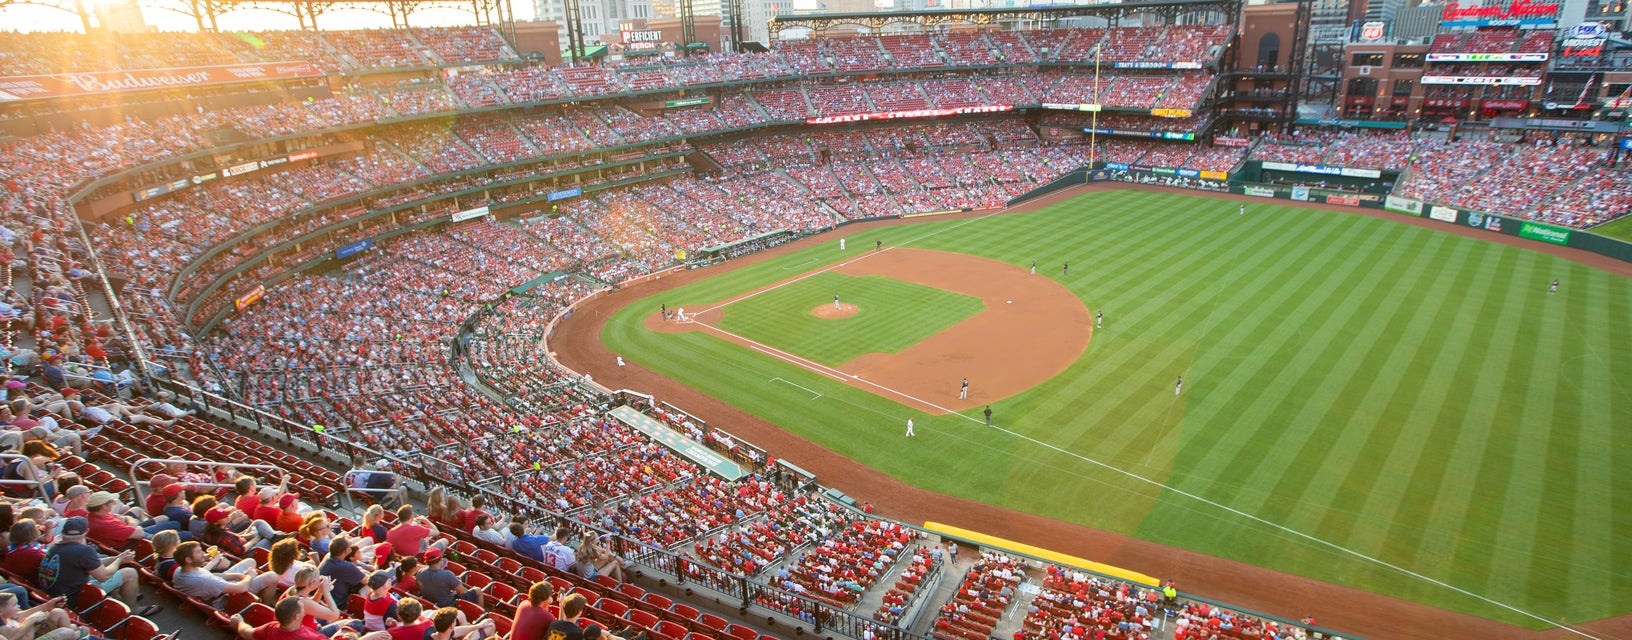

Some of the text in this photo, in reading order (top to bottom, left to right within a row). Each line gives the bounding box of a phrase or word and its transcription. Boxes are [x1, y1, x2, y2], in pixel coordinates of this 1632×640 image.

[1443, 0, 1559, 20] Cardinals Nation
[1364, 28, 1381, 37] 66
[1577, 25, 1598, 34] FOX
[623, 31, 662, 43] PERFICIENT
[1561, 38, 1607, 47] MIDWEST
[68, 71, 211, 92] Budweiser
[1532, 226, 1569, 239] National
